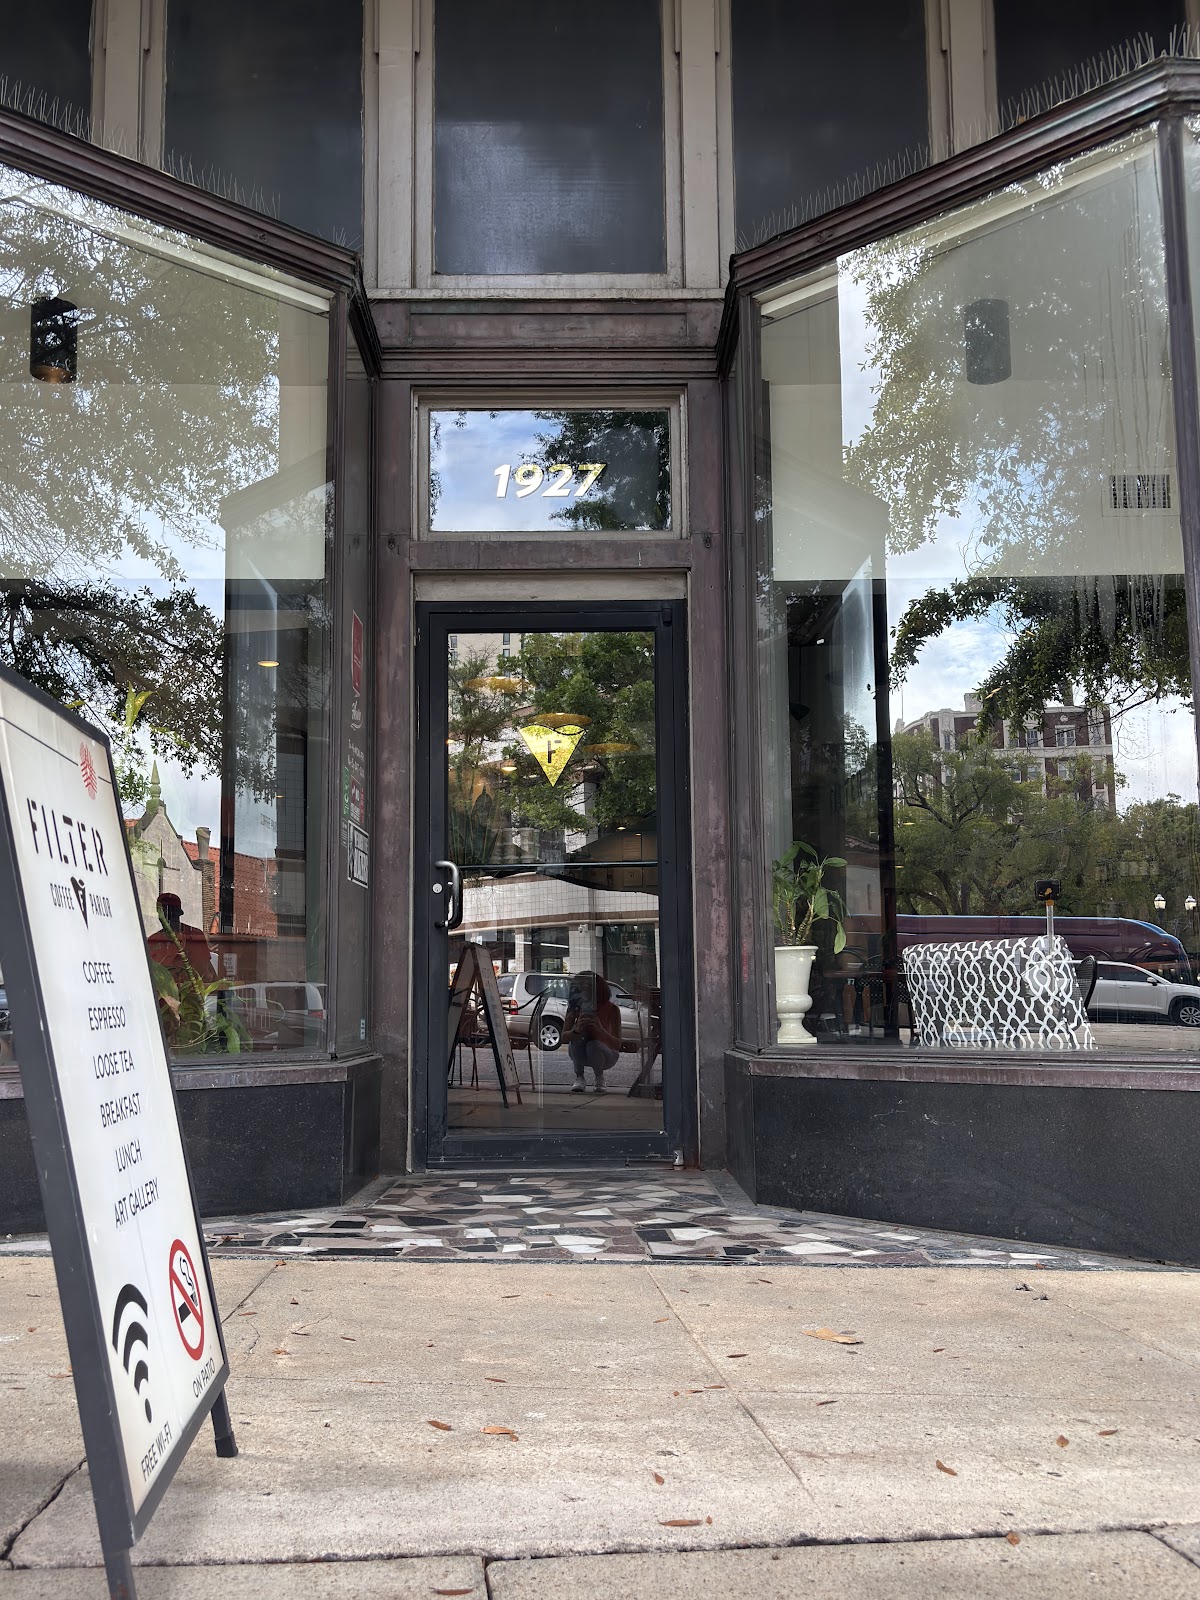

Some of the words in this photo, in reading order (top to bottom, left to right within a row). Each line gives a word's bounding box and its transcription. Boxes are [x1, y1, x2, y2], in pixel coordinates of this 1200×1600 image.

[494, 463, 607, 498] 1927
[27, 797, 108, 876] FILTER
[49, 882, 75, 911] COFFEE
[89, 892, 113, 918] PARLOR
[82, 961, 115, 984] COFFEE
[88, 1007, 126, 1031] ESPRESSO
[93, 1051, 119, 1080] LOOSE
[119, 1049, 135, 1072] TEA
[100, 1092, 142, 1129] BREAKFAST
[115, 1138, 143, 1173] LUNCH
[114, 1196, 130, 1229] ART
[129, 1177, 160, 1217] GALLERY
[192, 1373, 203, 1399] ON
[201, 1357, 216, 1387] PATIO
[141, 1444, 159, 1482] FREE
[155, 1420, 173, 1456] WI-FI
